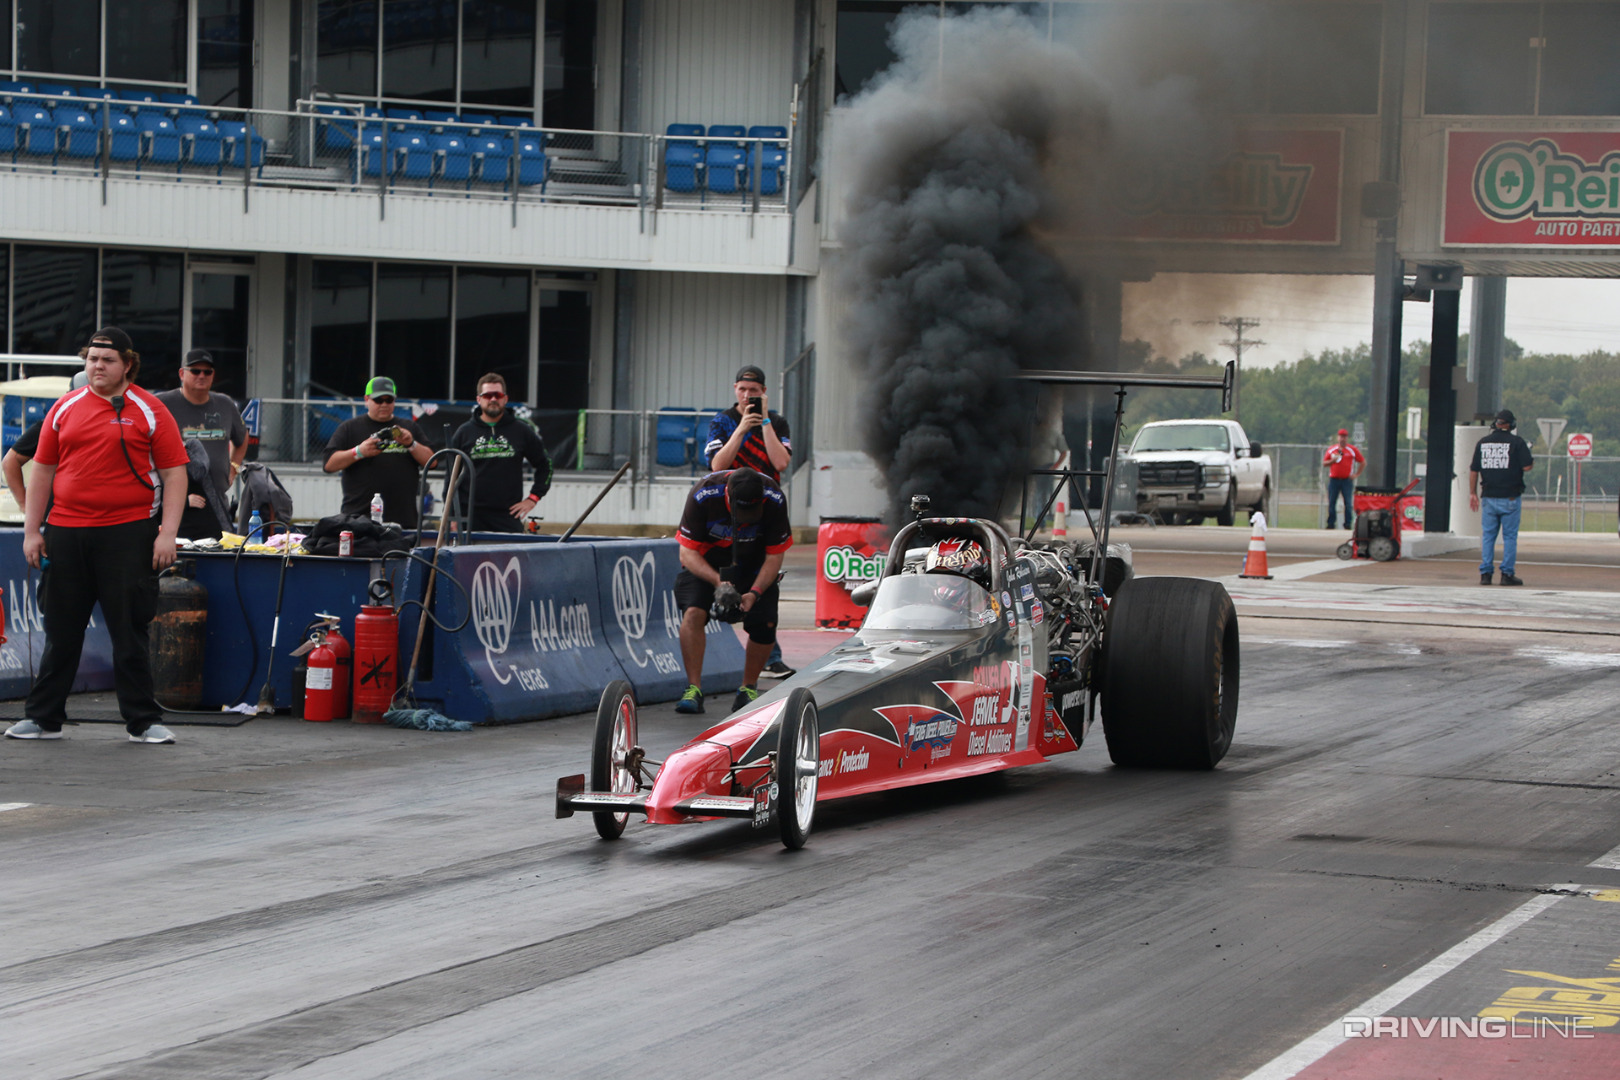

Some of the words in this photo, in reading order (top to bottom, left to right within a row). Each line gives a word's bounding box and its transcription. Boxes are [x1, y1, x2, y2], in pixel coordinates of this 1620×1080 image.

[1535, 222, 1578, 237] AUTO
[1481, 448, 1509, 458] TRACK
[1481, 458, 1509, 469] CREW
[530, 599, 595, 652] AAA.com
[646, 649, 681, 675] Texas
[509, 664, 549, 692] Texas
[973, 665, 1000, 697] POWER
[970, 696, 1000, 727] SERVICE
[967, 731, 987, 757] Diesel
[987, 728, 1012, 755] Additives
[818, 758, 834, 777] ance
[839, 746, 870, 774] Protection
